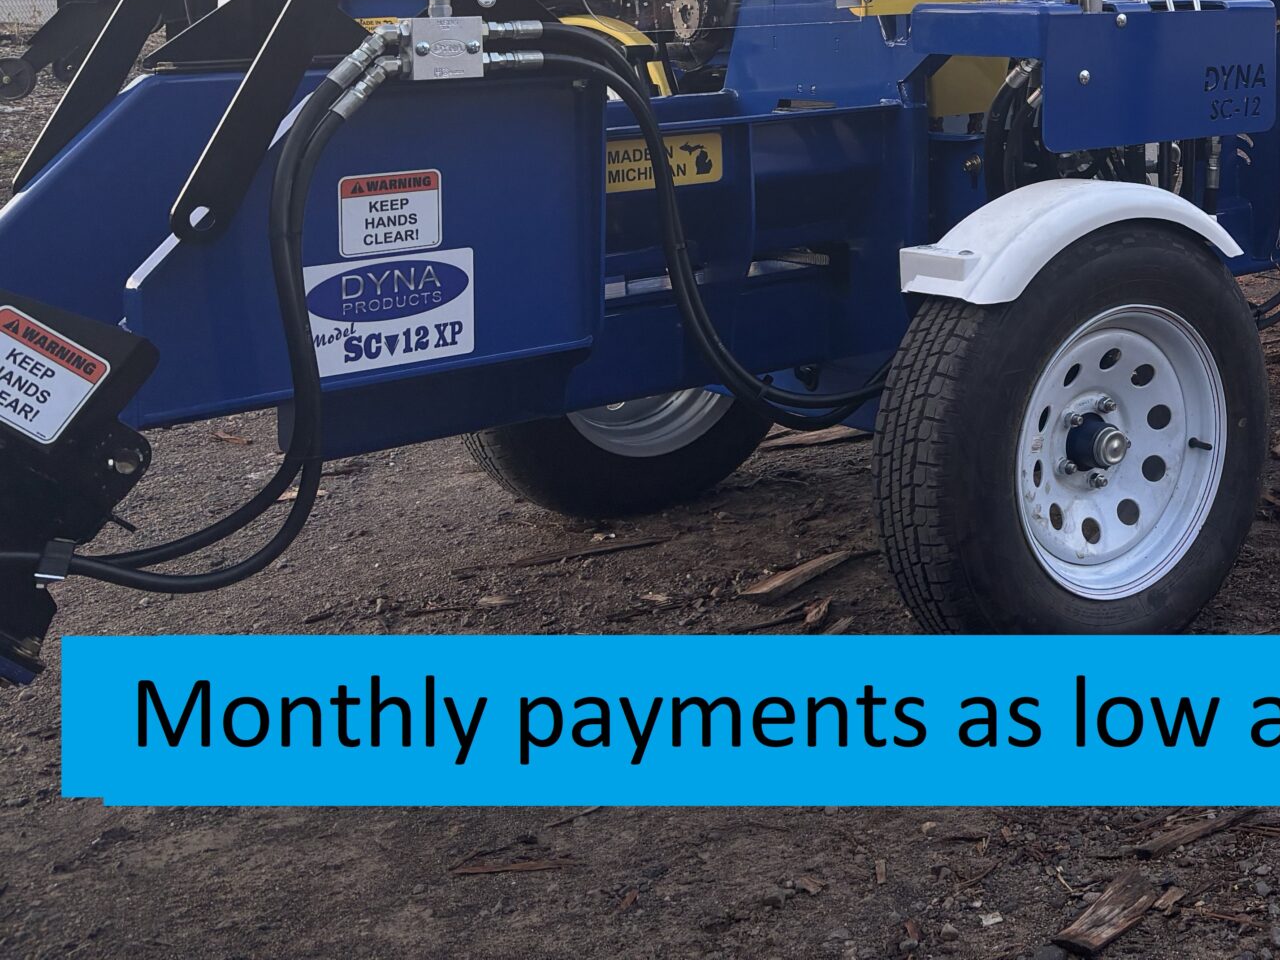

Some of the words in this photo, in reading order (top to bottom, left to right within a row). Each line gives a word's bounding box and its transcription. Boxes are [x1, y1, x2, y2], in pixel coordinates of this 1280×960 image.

[1204, 63, 1267, 92] DYNA
[1210, 96, 1261, 120] SC-12
[366, 176, 432, 192] WARNING
[608, 163, 687, 184] MICHIN
[369, 198, 409, 213] KEEP
[364, 213, 418, 230] HANDS
[363, 229, 419, 246] CLEAR!
[341, 265, 441, 300] DYNA
[342, 290, 442, 316] PRODUCTS
[313, 322, 357, 348] Model
[434, 320, 463, 349] XP
[5, 348, 56, 380] KEEP
[21, 326, 97, 376] WARNING
[0, 390, 40, 422] EAR!
